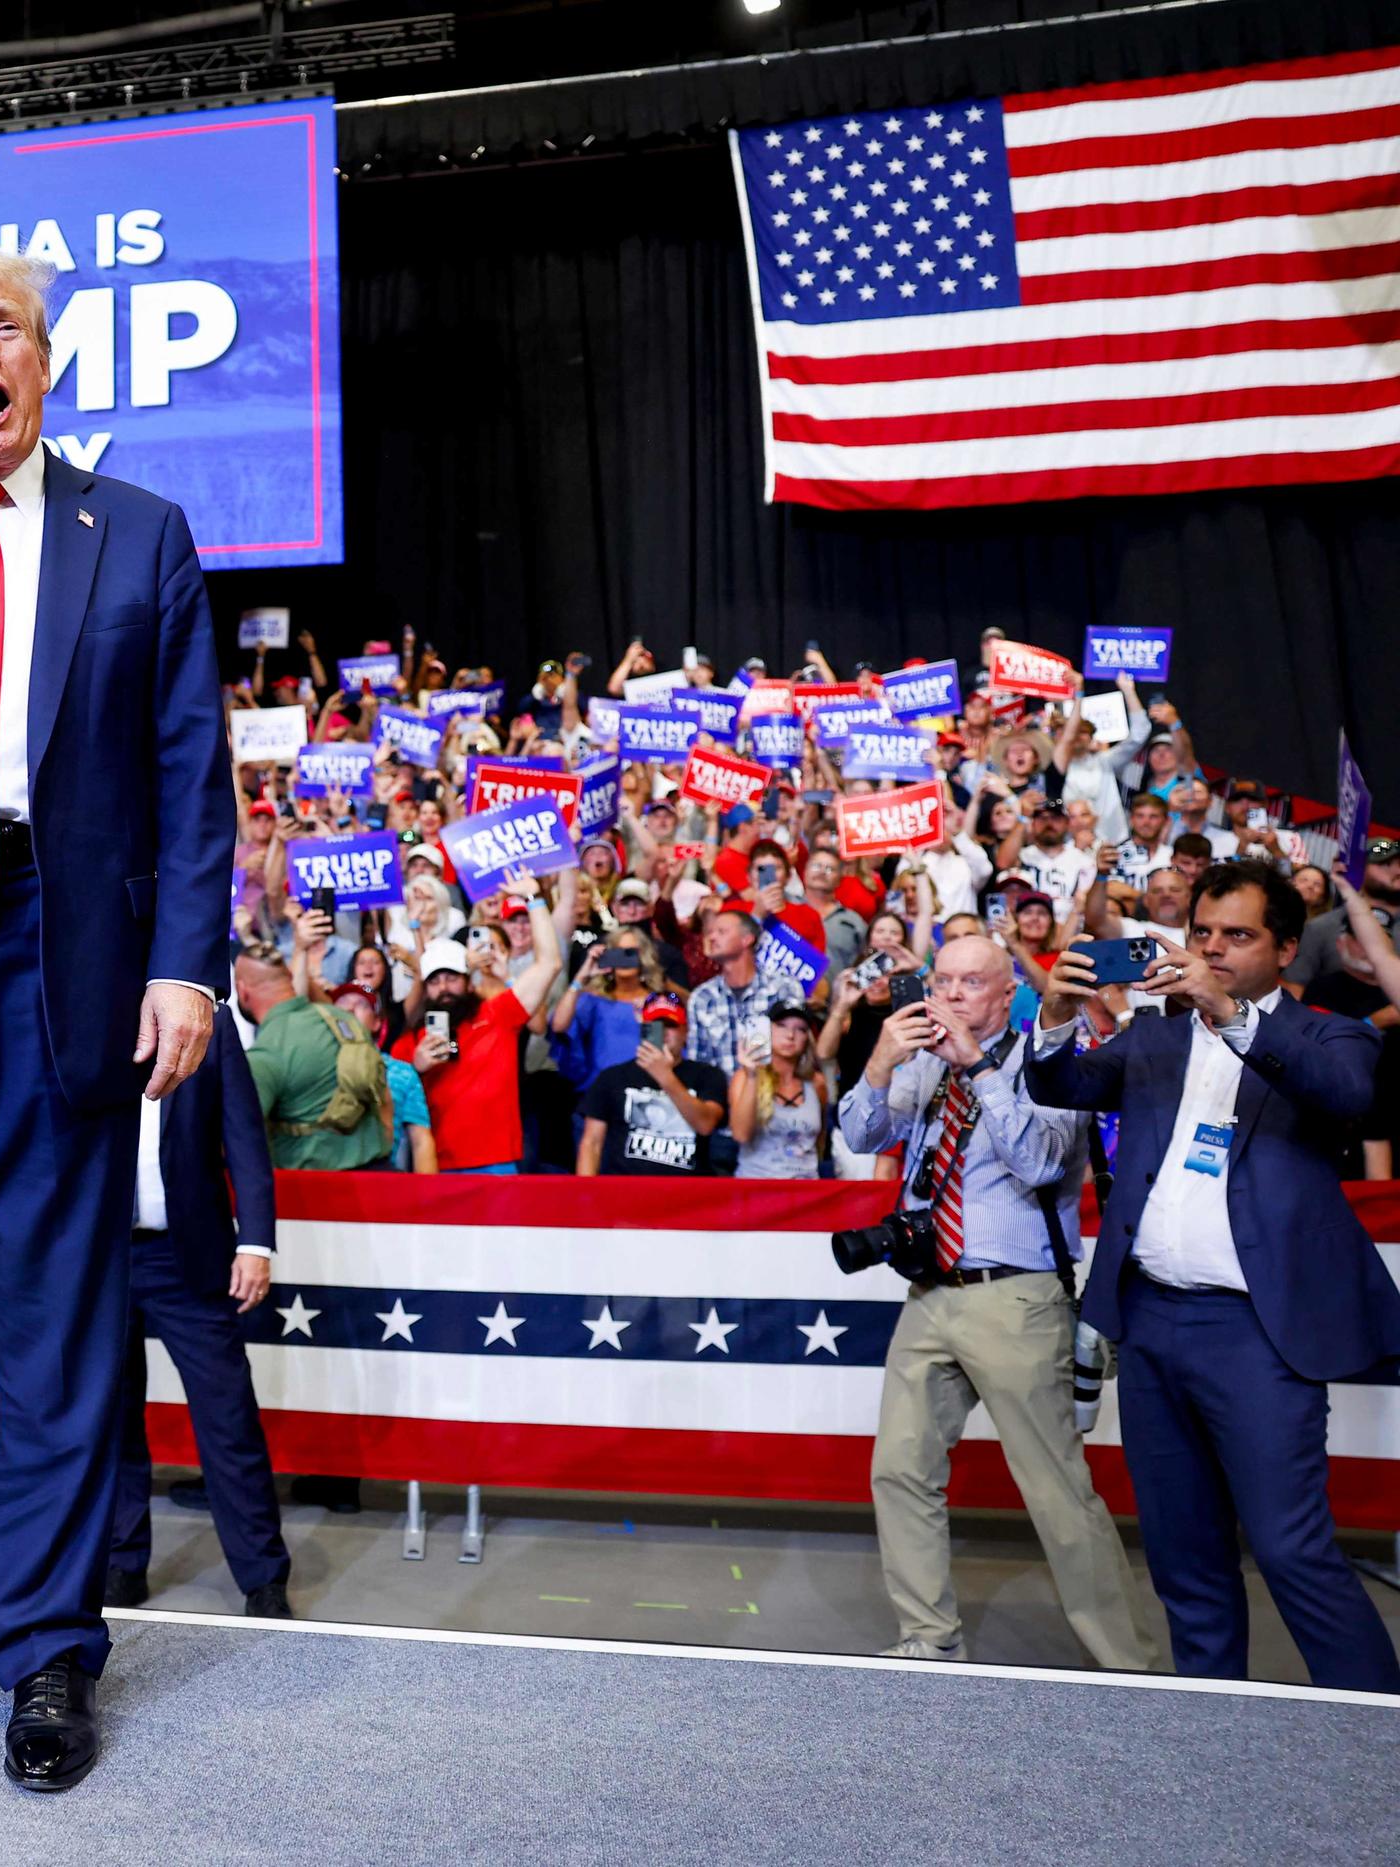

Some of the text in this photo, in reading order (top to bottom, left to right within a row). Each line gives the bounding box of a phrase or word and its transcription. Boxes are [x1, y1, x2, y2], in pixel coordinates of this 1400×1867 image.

[97, 208, 166, 268] IS
[1091, 638, 1167, 653] TRUMP
[1100, 650, 1159, 665] VANCE
[886, 675, 953, 703] TRUMP
[897, 689, 949, 708] VANCE
[674, 697, 738, 720] TRUMP
[818, 708, 892, 726] TRUMP
[380, 714, 442, 743] TRUMP
[622, 717, 698, 736] TRUMP
[629, 731, 690, 748] VANCE
[850, 734, 932, 753] TRUMP
[299, 755, 372, 771] TRUMP
[861, 747, 926, 764] VANCE
[306, 767, 364, 786] VANCE
[691, 758, 765, 790] TRUMP
[481, 780, 576, 810] TRUP
[844, 797, 939, 826] TRUMP
[454, 810, 558, 860] TRUMP
[856, 815, 932, 842] VANCE
[471, 831, 557, 870] VANCE
[293, 849, 394, 879] TRUMP
[304, 867, 385, 889] VANCE
[758, 930, 816, 982] RUMP
[630, 1133, 697, 1161] TRUMP
[1199, 1132, 1225, 1146] PRESS
